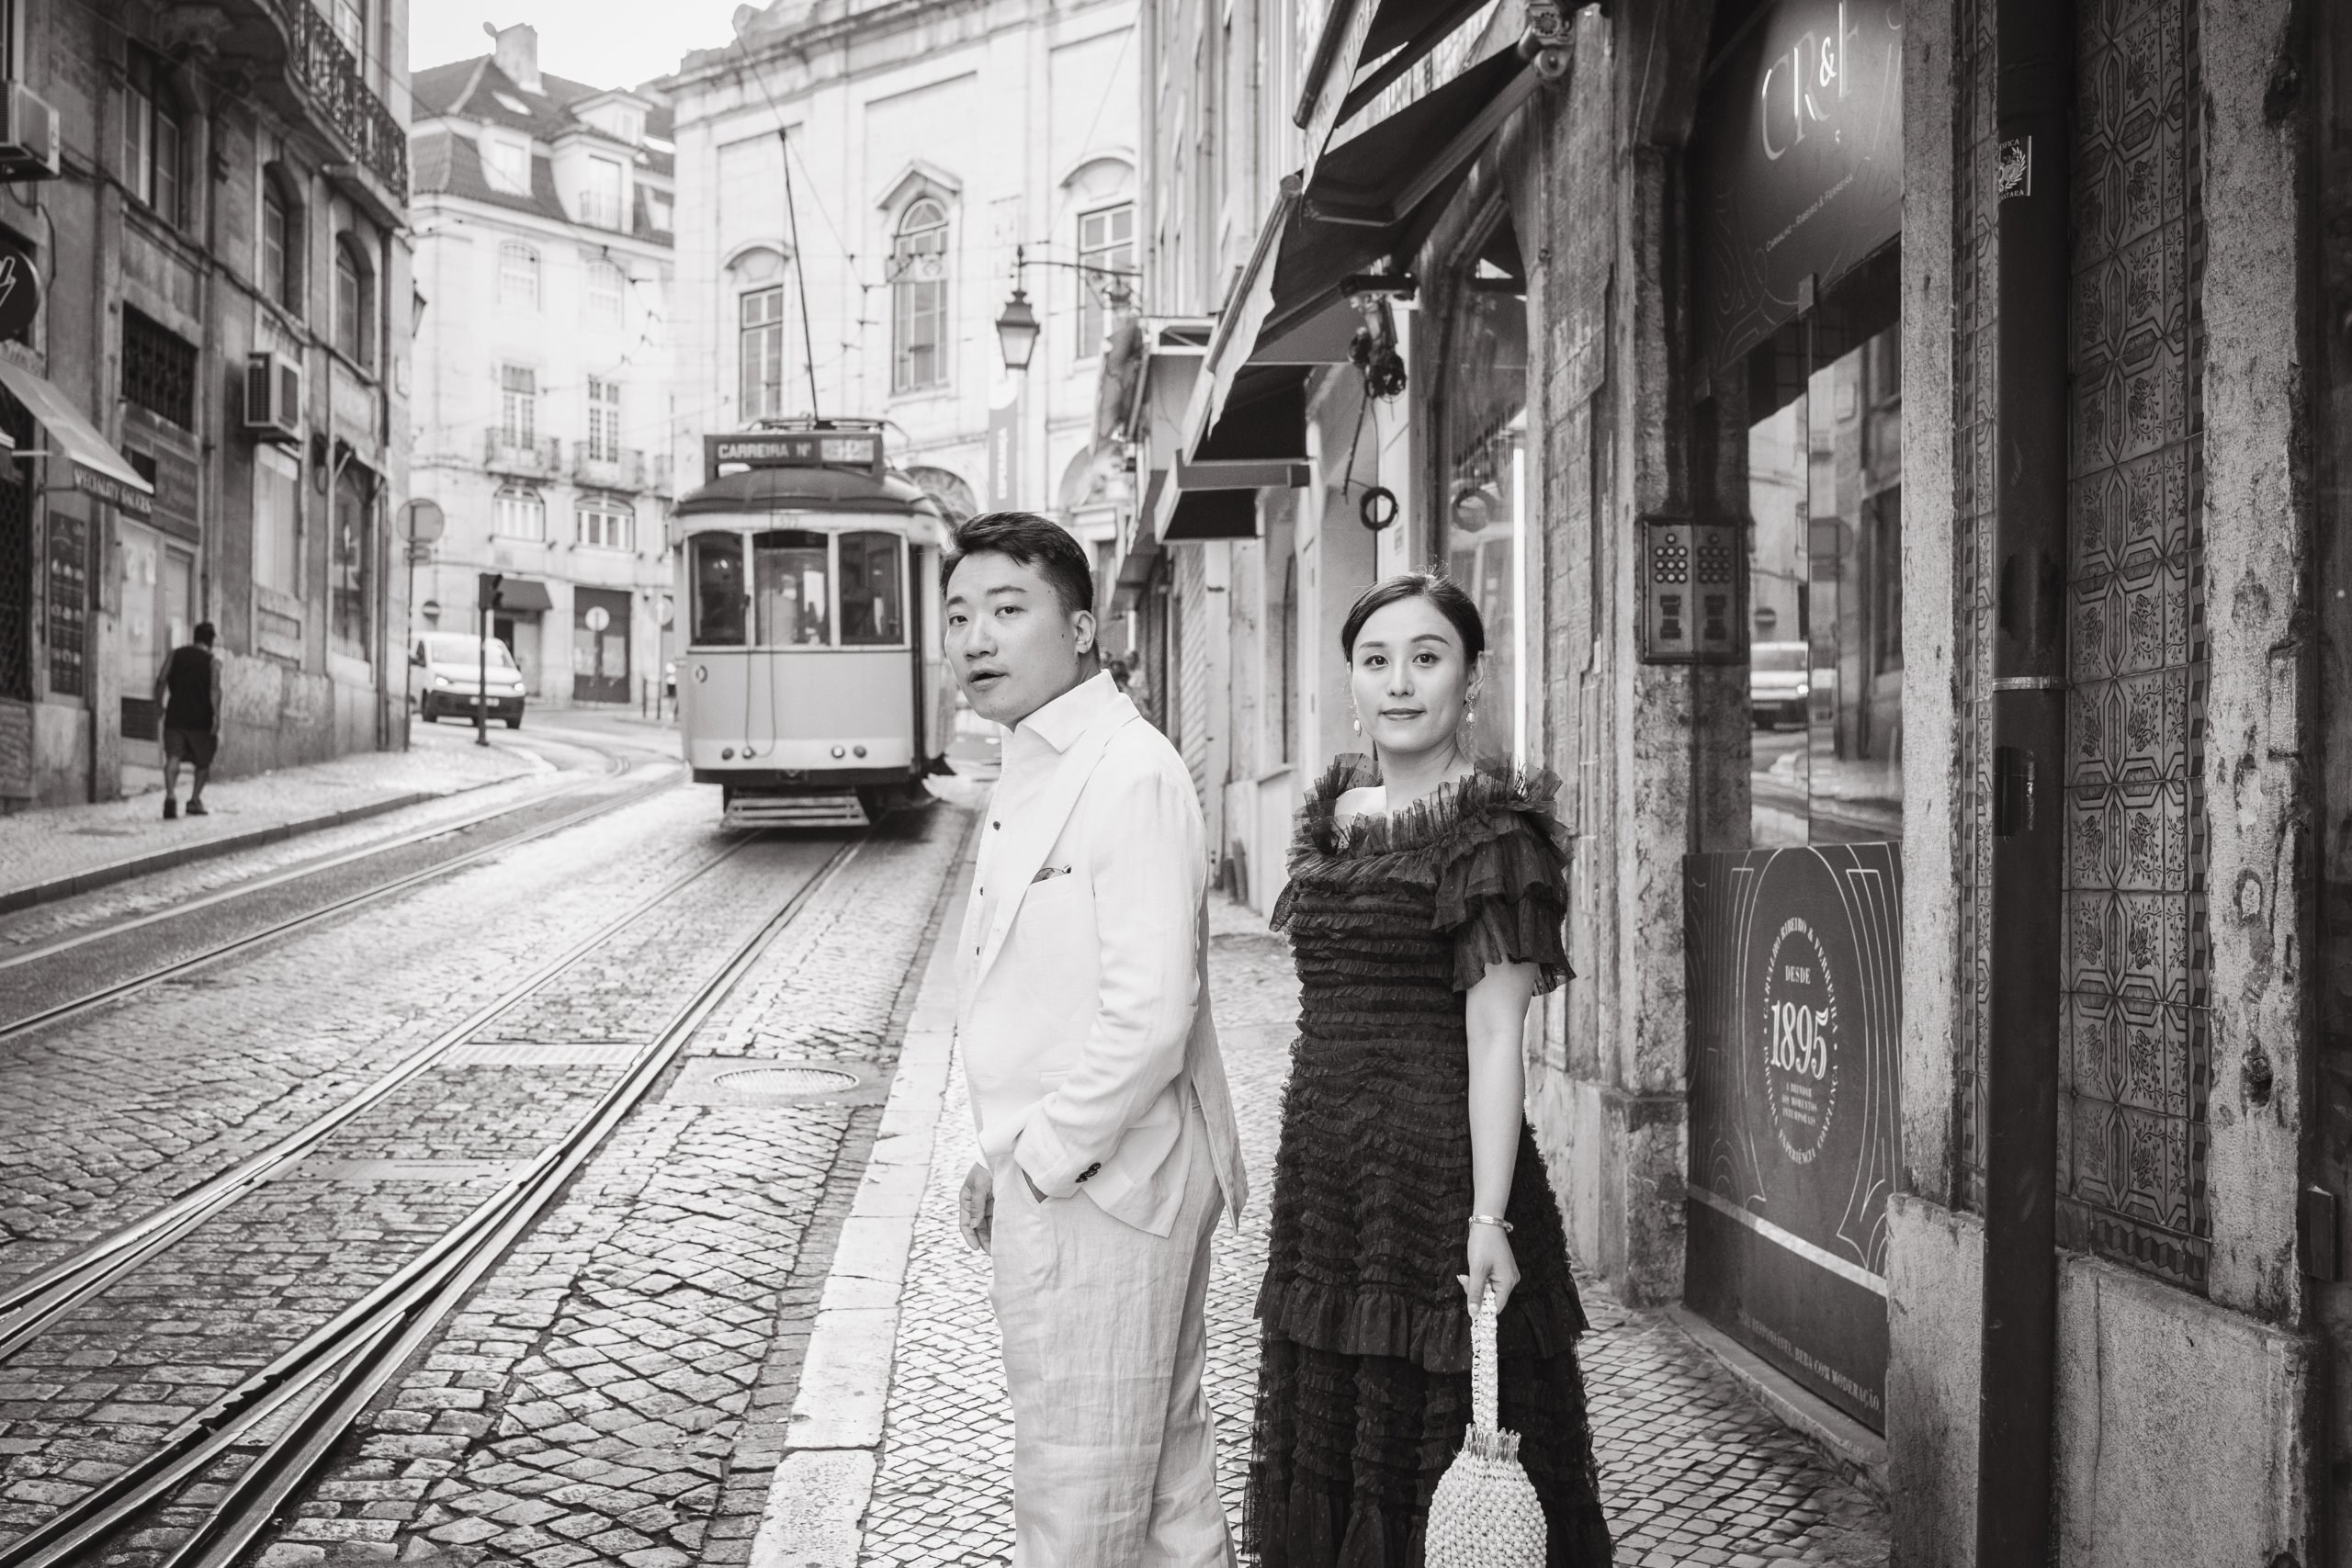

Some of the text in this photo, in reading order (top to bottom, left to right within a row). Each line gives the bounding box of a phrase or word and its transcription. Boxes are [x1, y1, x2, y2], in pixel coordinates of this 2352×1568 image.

[718, 442, 790, 459] CARREIRA
[1781, 917, 1807, 941] RIBEIRO
[1807, 927, 1814, 942] &
[1814, 937, 1838, 1034] FERREIRA
[1785, 964, 1811, 985] DESDE
[1770, 999, 1829, 1080] 1895
[1794, 1347, 1814, 1371] BEBA
[1814, 1359, 1830, 1382] COM
